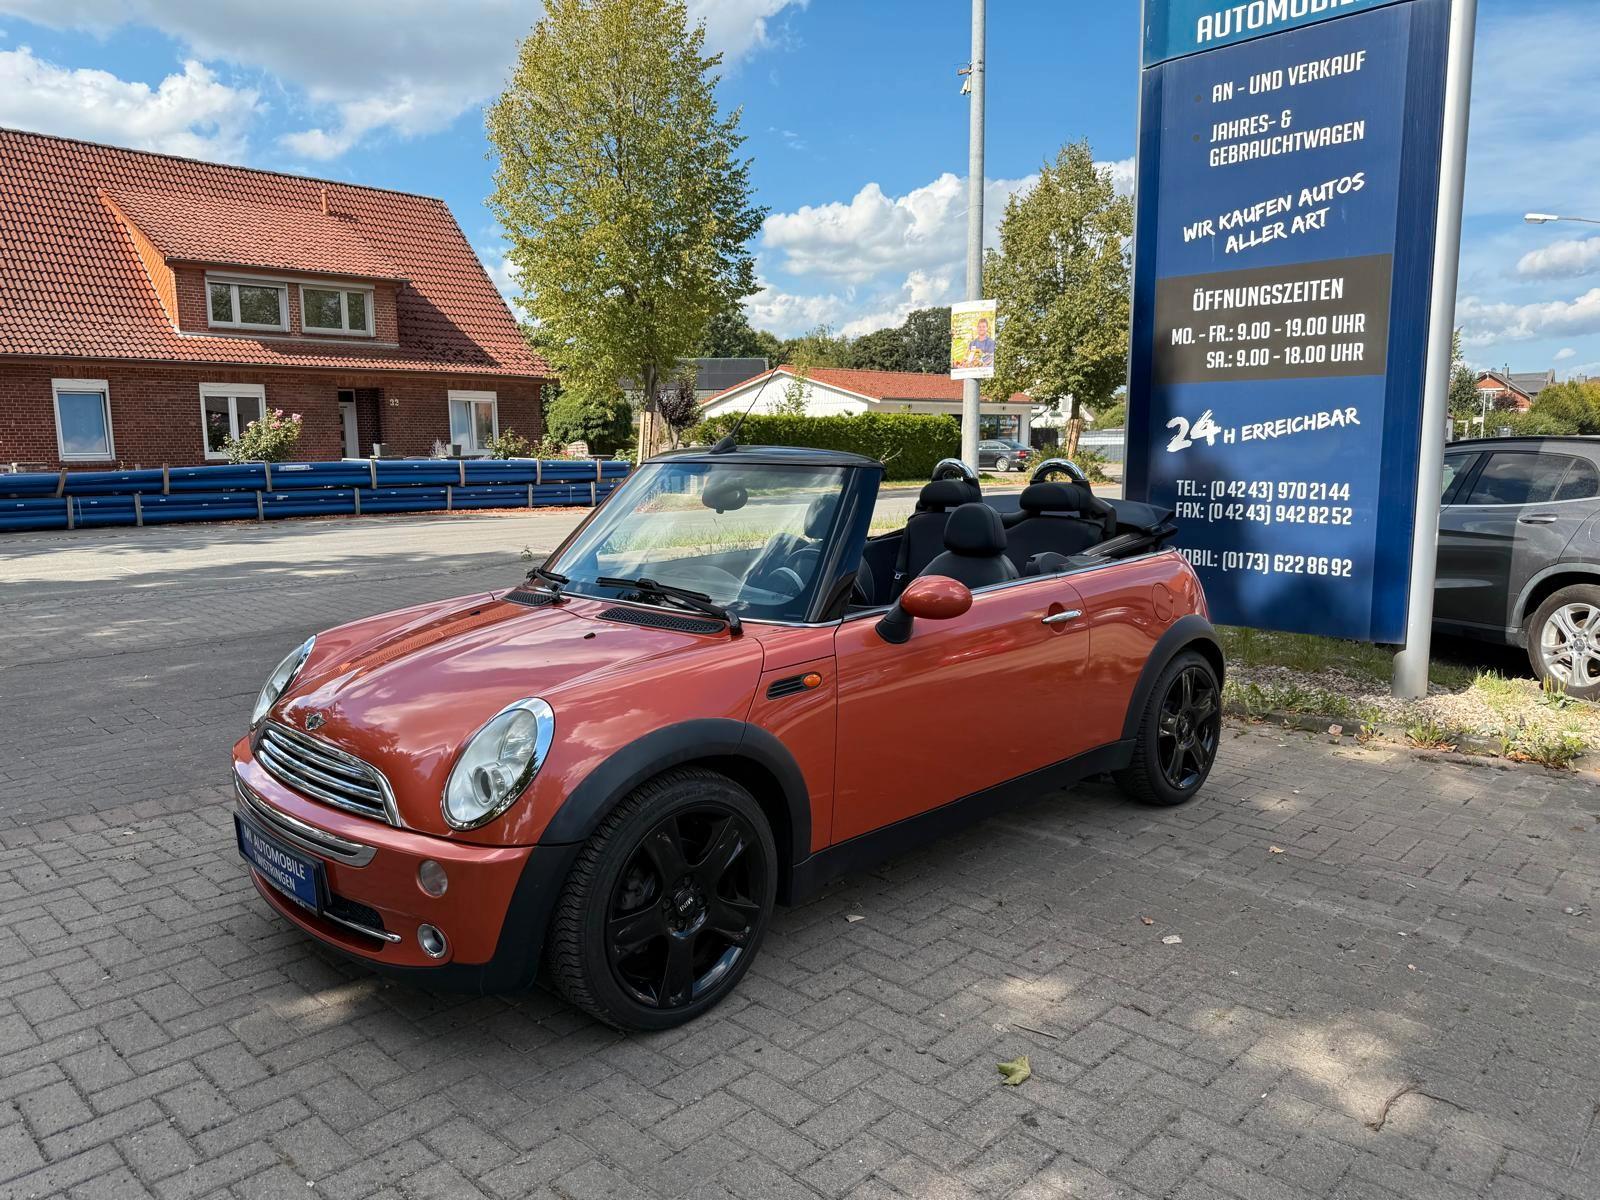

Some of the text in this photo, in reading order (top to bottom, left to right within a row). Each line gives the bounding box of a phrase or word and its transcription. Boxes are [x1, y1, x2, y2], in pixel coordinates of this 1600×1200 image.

[1212, 81, 1233, 103] AN
[1249, 70, 1283, 96] UND
[1288, 50, 1367, 86] VERKAUF
[1210, 110, 1292, 142] JAHRES- &
[1209, 121, 1366, 167] GEBRAUCHTWAGEN
[1183, 172, 1366, 243] WIR KAUFEN AUTOS
[1224, 207, 1331, 254] ALLER ART
[1192, 277, 1344, 312] ÖFFNUNGSZEITEN
[1171, 327, 1196, 346] MO.
[1237, 321, 1271, 341] 9.00
[1285, 316, 1327, 338] 19.00
[1332, 313, 1366, 334] UHR
[1236, 348, 1270, 367] 9.00
[1284, 345, 1326, 365] 18.00
[1331, 342, 1364, 362] UHR
[1241, 407, 1361, 442] ERREICHBAR
[1176, 479, 1207, 497] TEL.:
[1175, 502, 1205, 519] FAX:
[1178, 548, 1218, 567] OBIL:
[253, 834, 306, 880] AUTOMOBILE
